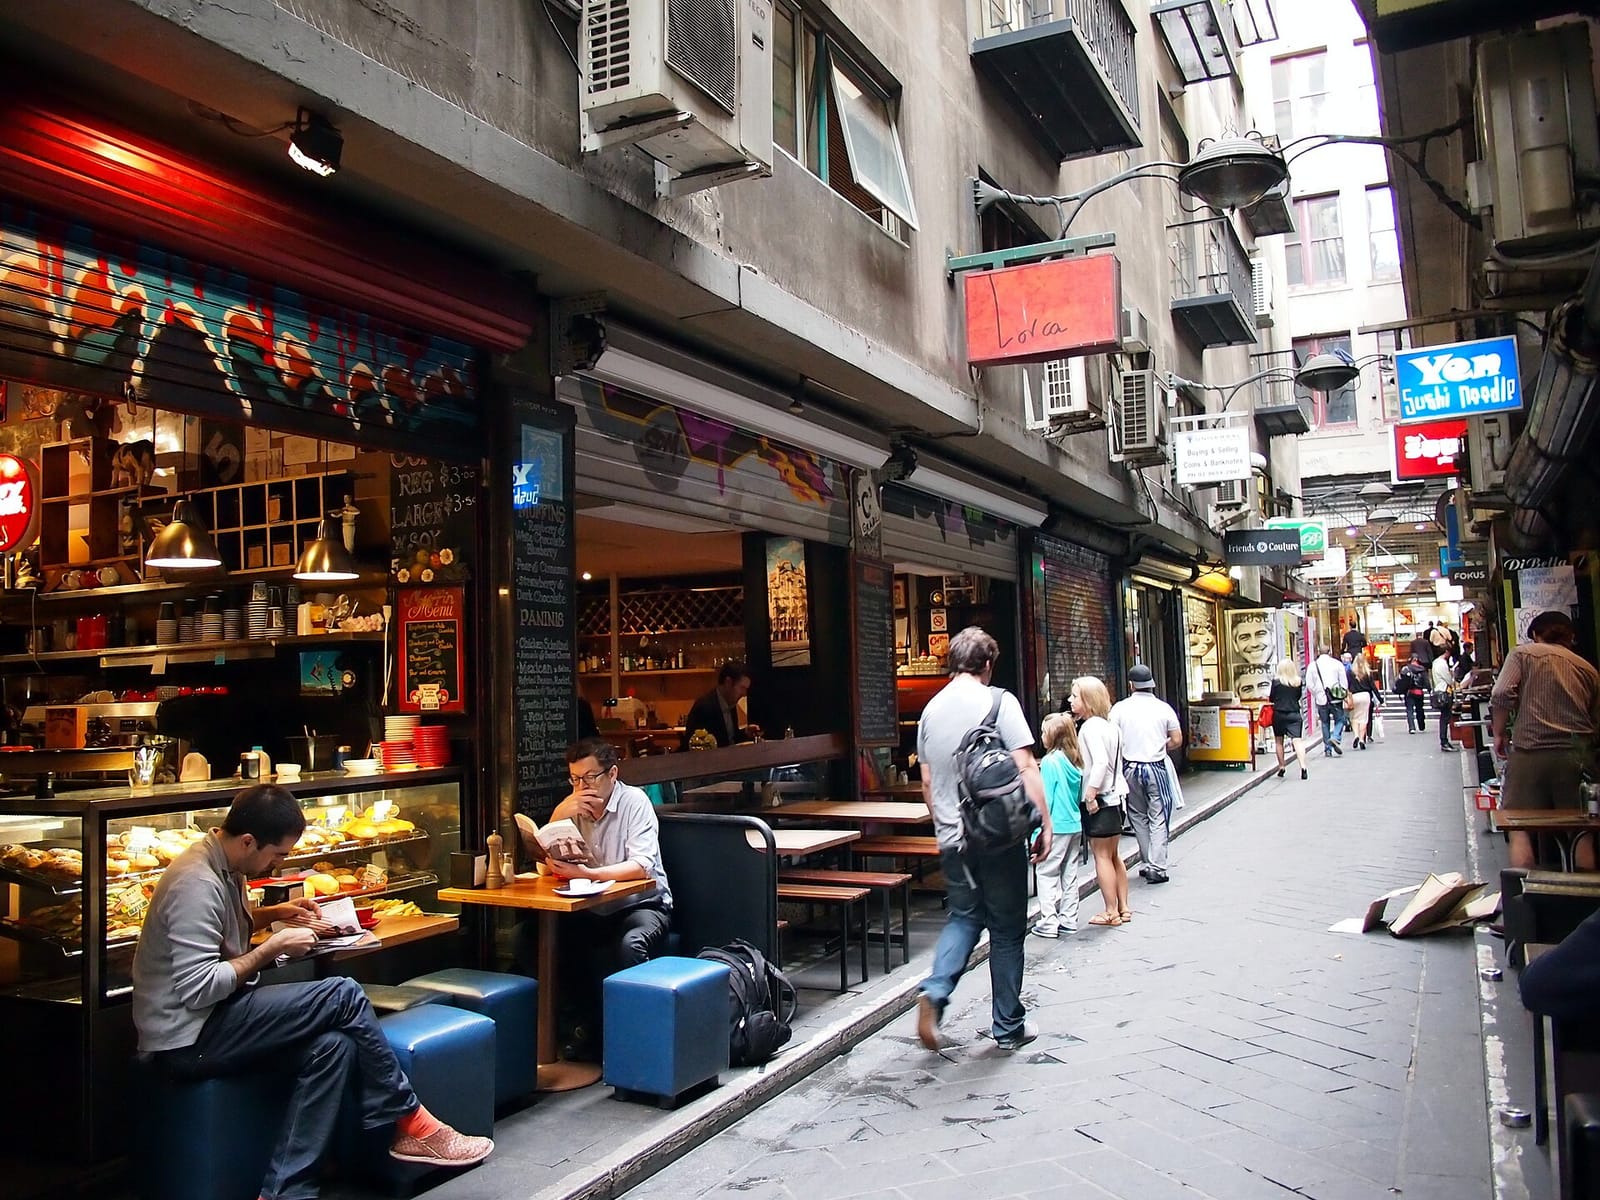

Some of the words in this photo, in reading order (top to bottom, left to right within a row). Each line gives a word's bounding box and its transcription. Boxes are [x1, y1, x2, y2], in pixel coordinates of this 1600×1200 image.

[988, 274, 1068, 349] Lorca
[1408, 353, 1502, 386] Yen
[1402, 384, 1450, 416] Sushi
[1187, 448, 1209, 457] Buying
[1218, 446, 1239, 454] Selling
[1210, 458, 1243, 467] Banknotes
[398, 470, 434, 496] REG
[1228, 543, 1255, 553] Friends
[1268, 541, 1299, 553] Couture
[1454, 570, 1485, 580] FOKUS
[408, 605, 453, 619] Menu
[520, 608, 565, 627] PANINIS
[519, 660, 552, 674] Mexican
